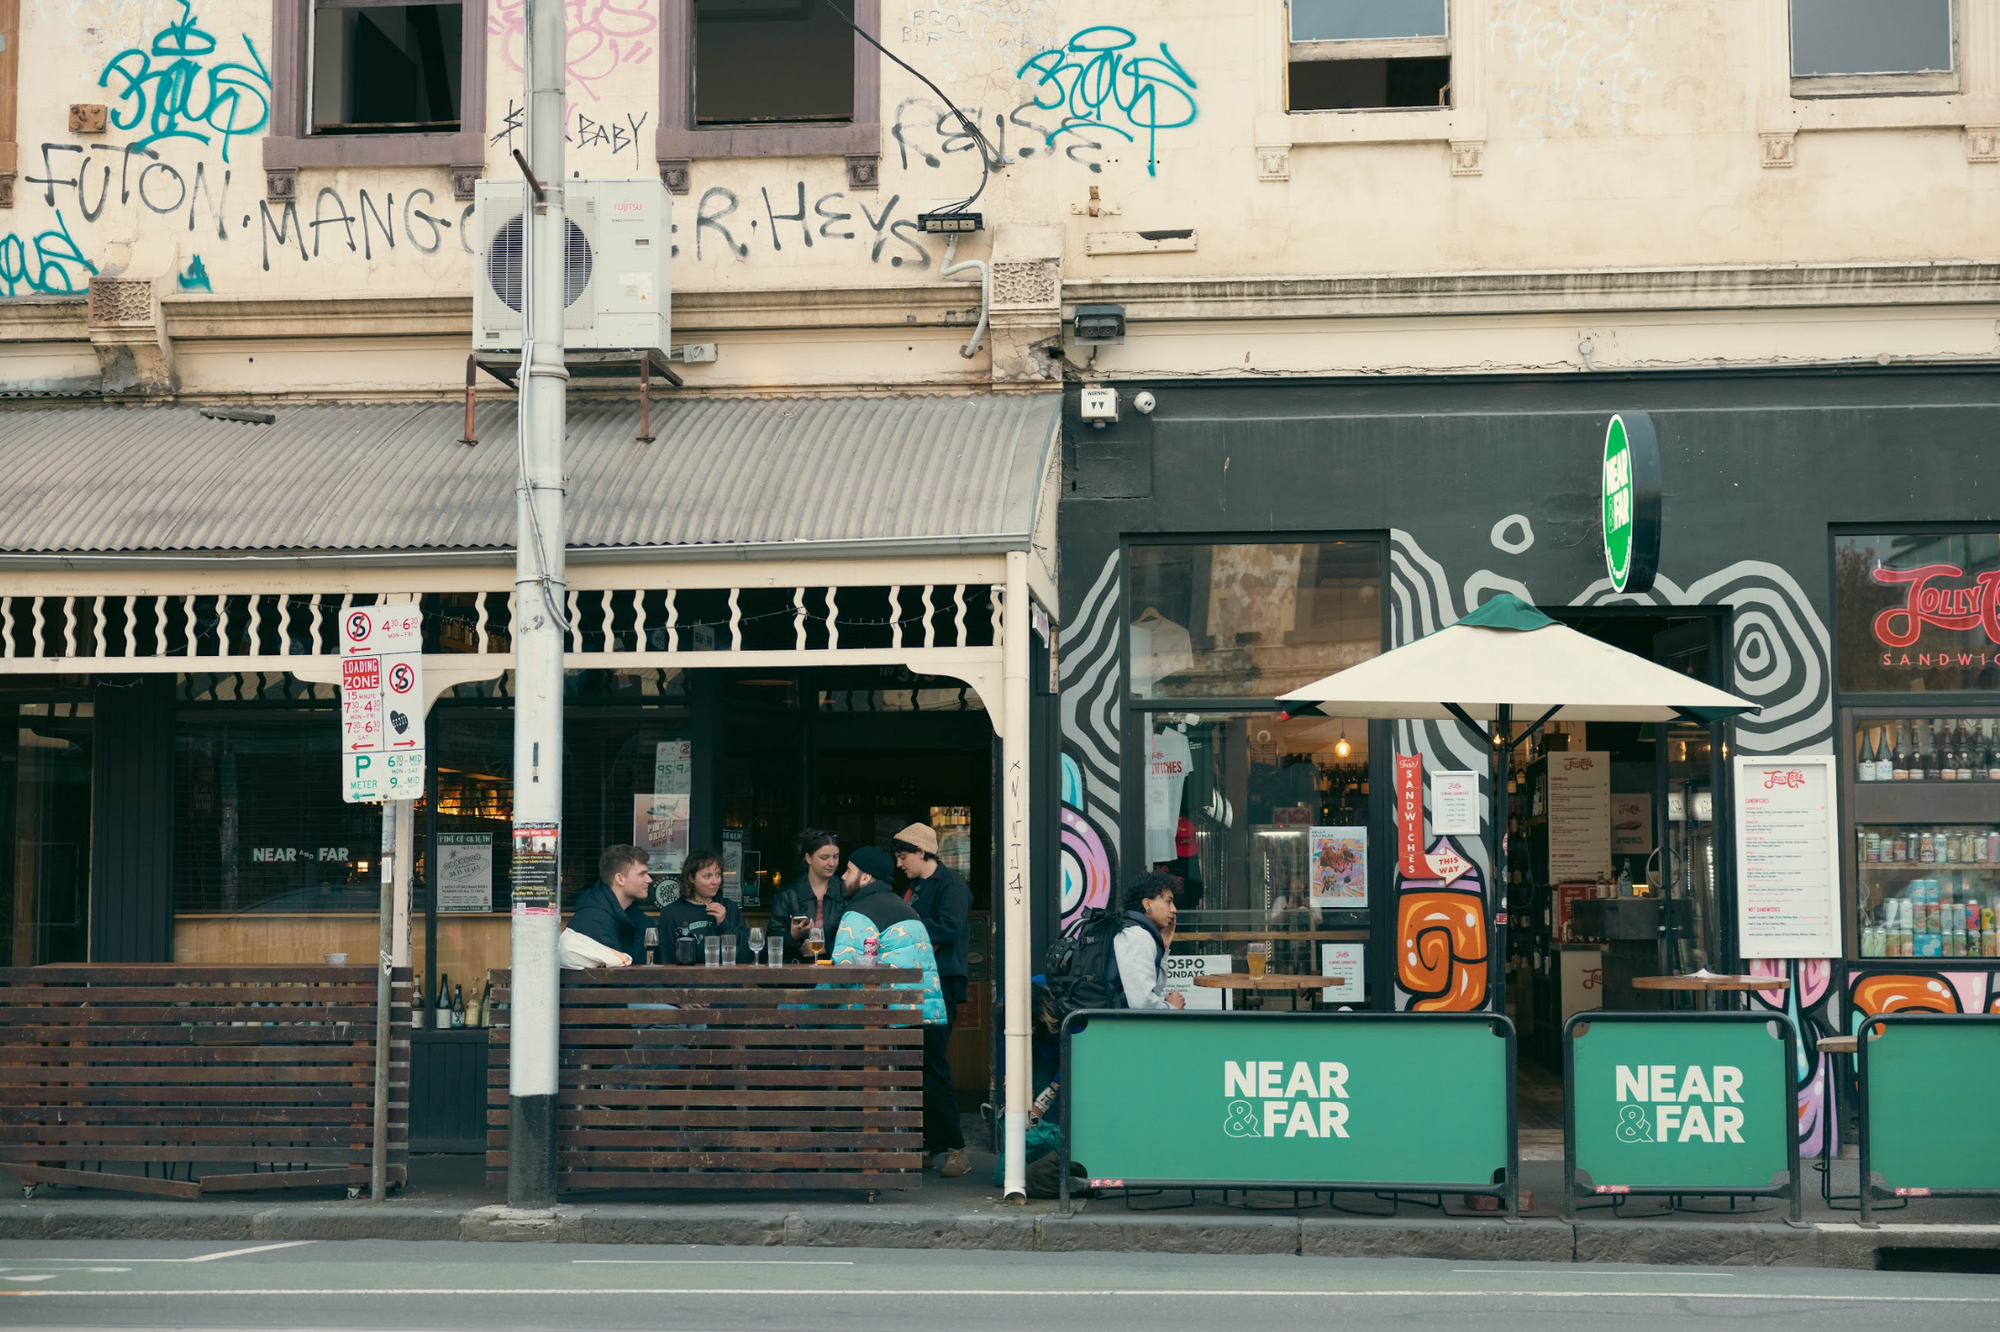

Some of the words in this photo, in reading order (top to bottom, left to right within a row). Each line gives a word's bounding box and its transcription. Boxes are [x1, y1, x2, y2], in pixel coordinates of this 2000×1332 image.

[577, 111, 648, 170] BABY
[614, 202, 642, 213] FUJITSU
[1605, 448, 1629, 496] NEAR
[1614, 487, 1630, 531] FAR
[1873, 564, 1982, 647] JOLLY
[344, 660, 377, 674] LOADING
[344, 675, 379, 689] ZONE
[347, 692, 358, 700] 15
[355, 755, 371, 778] P
[350, 780, 378, 790] METER
[389, 777, 398, 789] 9
[1763, 770, 1787, 789] JOLLY
[1786, 768, 1806, 789] GOOD
[647, 822, 664, 833] PINT
[1404, 769, 1416, 874] SANDWICHES
[439, 835, 454, 843] PINT
[456, 835, 464, 843] OF
[466, 834, 491, 843] ORIGIN
[648, 828, 674, 842] ORIGIN
[252, 847, 297, 863] NEAR
[299, 850, 314, 860] AND
[317, 847, 349, 863] FAR
[1439, 856, 1459, 866] THIS
[1439, 865, 1460, 875] WAY
[660, 883, 678, 893] GOOD
[660, 888, 675, 898] BEER
[1225, 1061, 1349, 1098] NEAR
[1616, 1065, 1744, 1103] NEAR
[1223, 1100, 1261, 1138] &
[1264, 1100, 1350, 1138] FAR
[1615, 1104, 1655, 1143] &
[1657, 1105, 1744, 1143] FAR
